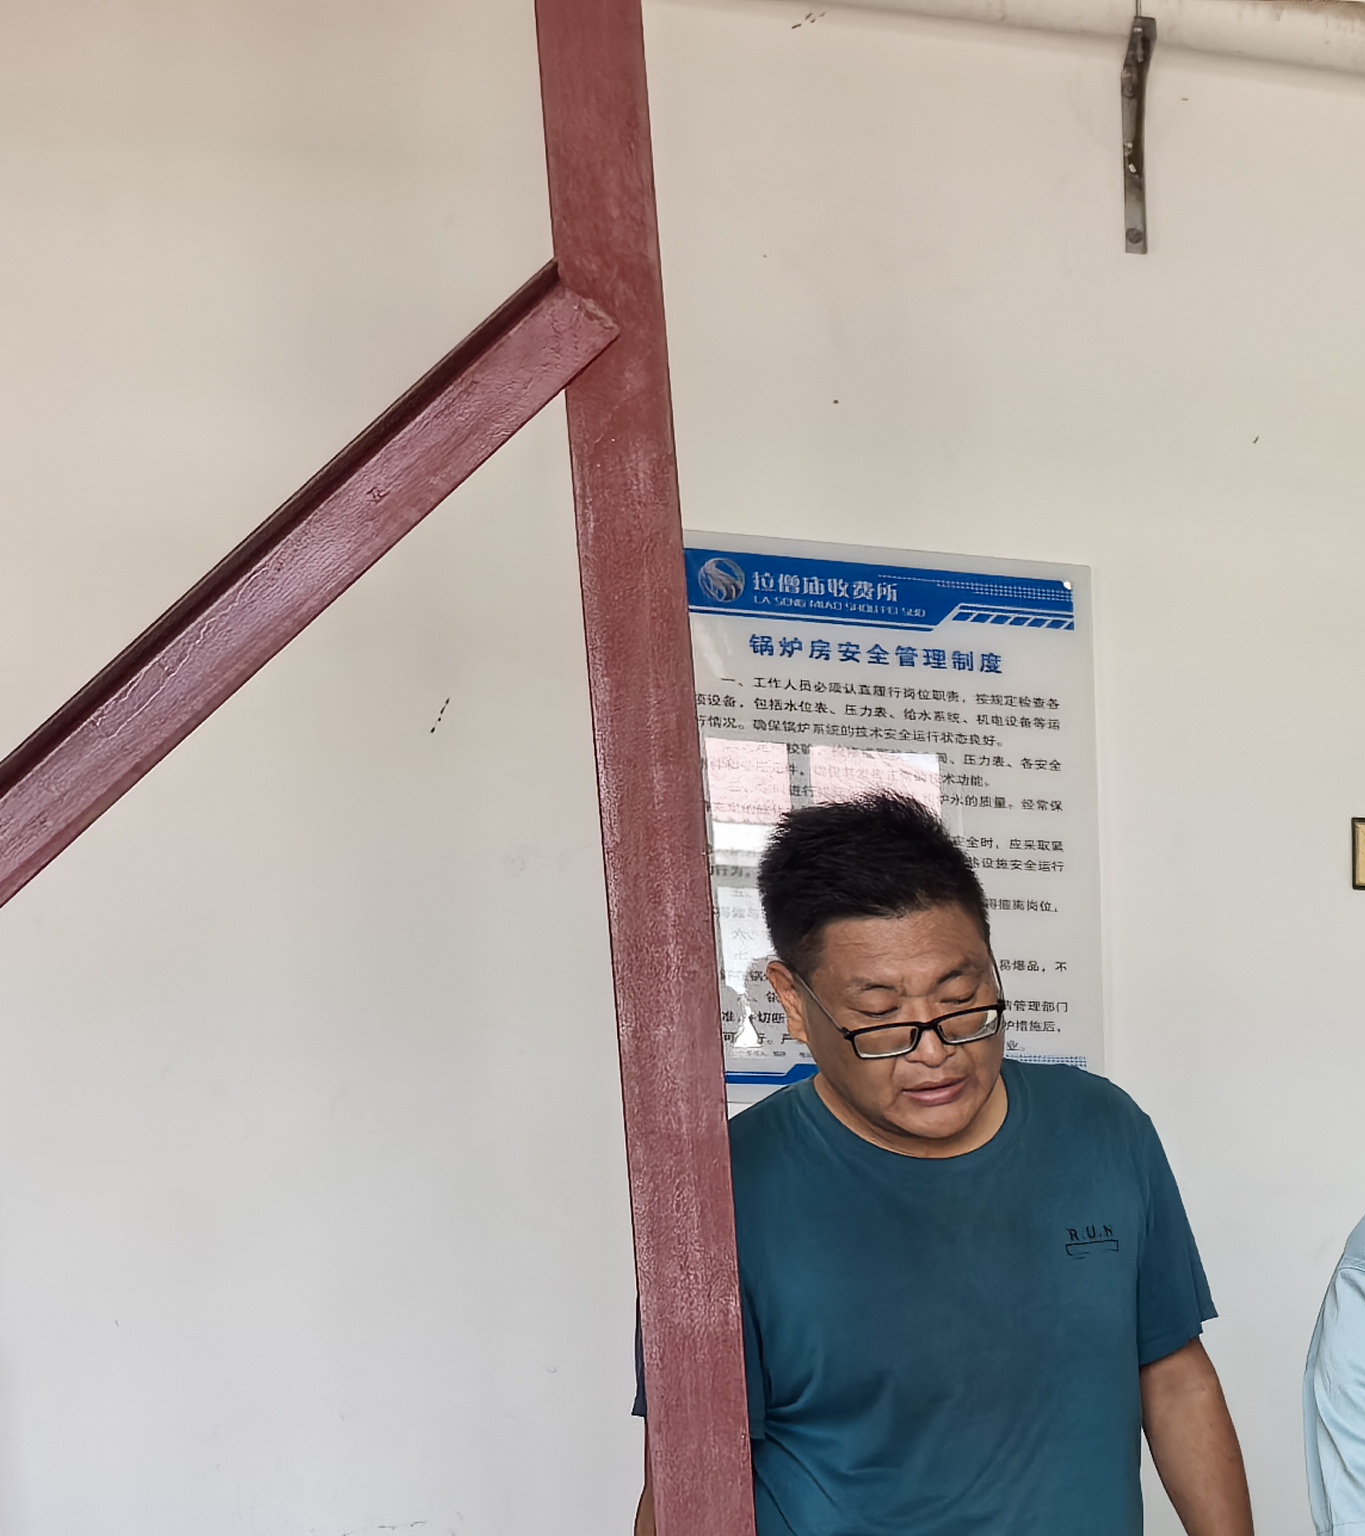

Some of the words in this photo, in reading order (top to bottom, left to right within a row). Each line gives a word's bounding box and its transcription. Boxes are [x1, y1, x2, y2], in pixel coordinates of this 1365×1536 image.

[753, 571, 898, 602] 拉僧庙收费所
[753, 595, 771, 604] LA
[749, 633, 1003, 674] 锅炉房安全管理制度
